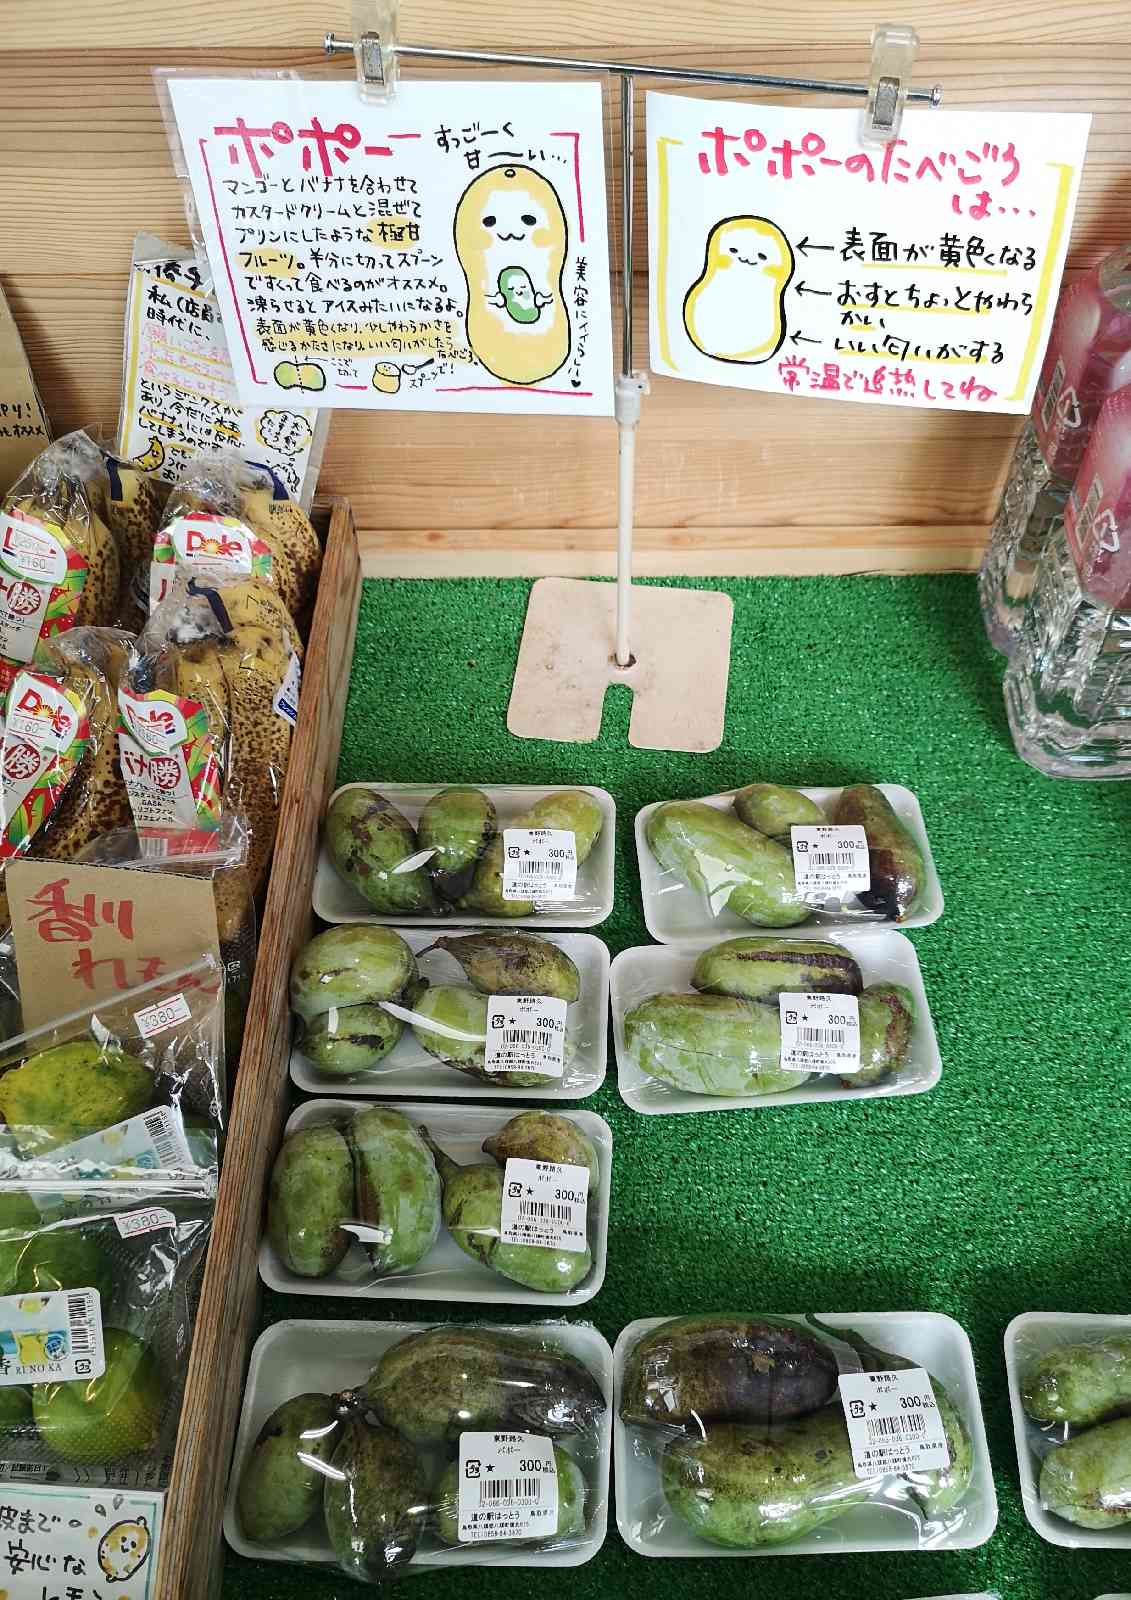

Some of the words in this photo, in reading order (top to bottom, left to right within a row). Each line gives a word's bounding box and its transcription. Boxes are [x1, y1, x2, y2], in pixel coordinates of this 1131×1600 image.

[214, 117, 394, 178] ポポー
[434, 122, 514, 154] すっごーく
[699, 127, 1021, 187] ポポーのたべごろ
[222, 174, 419, 195] マンゴーとバナナを合わせて
[232, 199, 422, 220] カスタードクリームと混ぜて
[235, 222, 420, 244] プリンにしたような極甘
[840, 227, 1036, 271] 表面が黄色くなる
[245, 272, 448, 293] ですくって食べるのがオススメ。
[837, 280, 1033, 315] おすとちょっとやわら
[840, 311, 886, 328] かい
[834, 335, 1005, 364] いい匂いがする
[837, 840, 854, 849] 300
[26, 878, 133, 942] 香川
[536, 1017, 554, 1028] 300
[828, 1014, 846, 1024] 300
[555, 1188, 575, 1201] 300
[900, 1395, 921, 1409] 300
[520, 1460, 541, 1472] 300
[4, 1539, 86, 1575] 安心な
[42, 1586, 103, 1600] レモ
